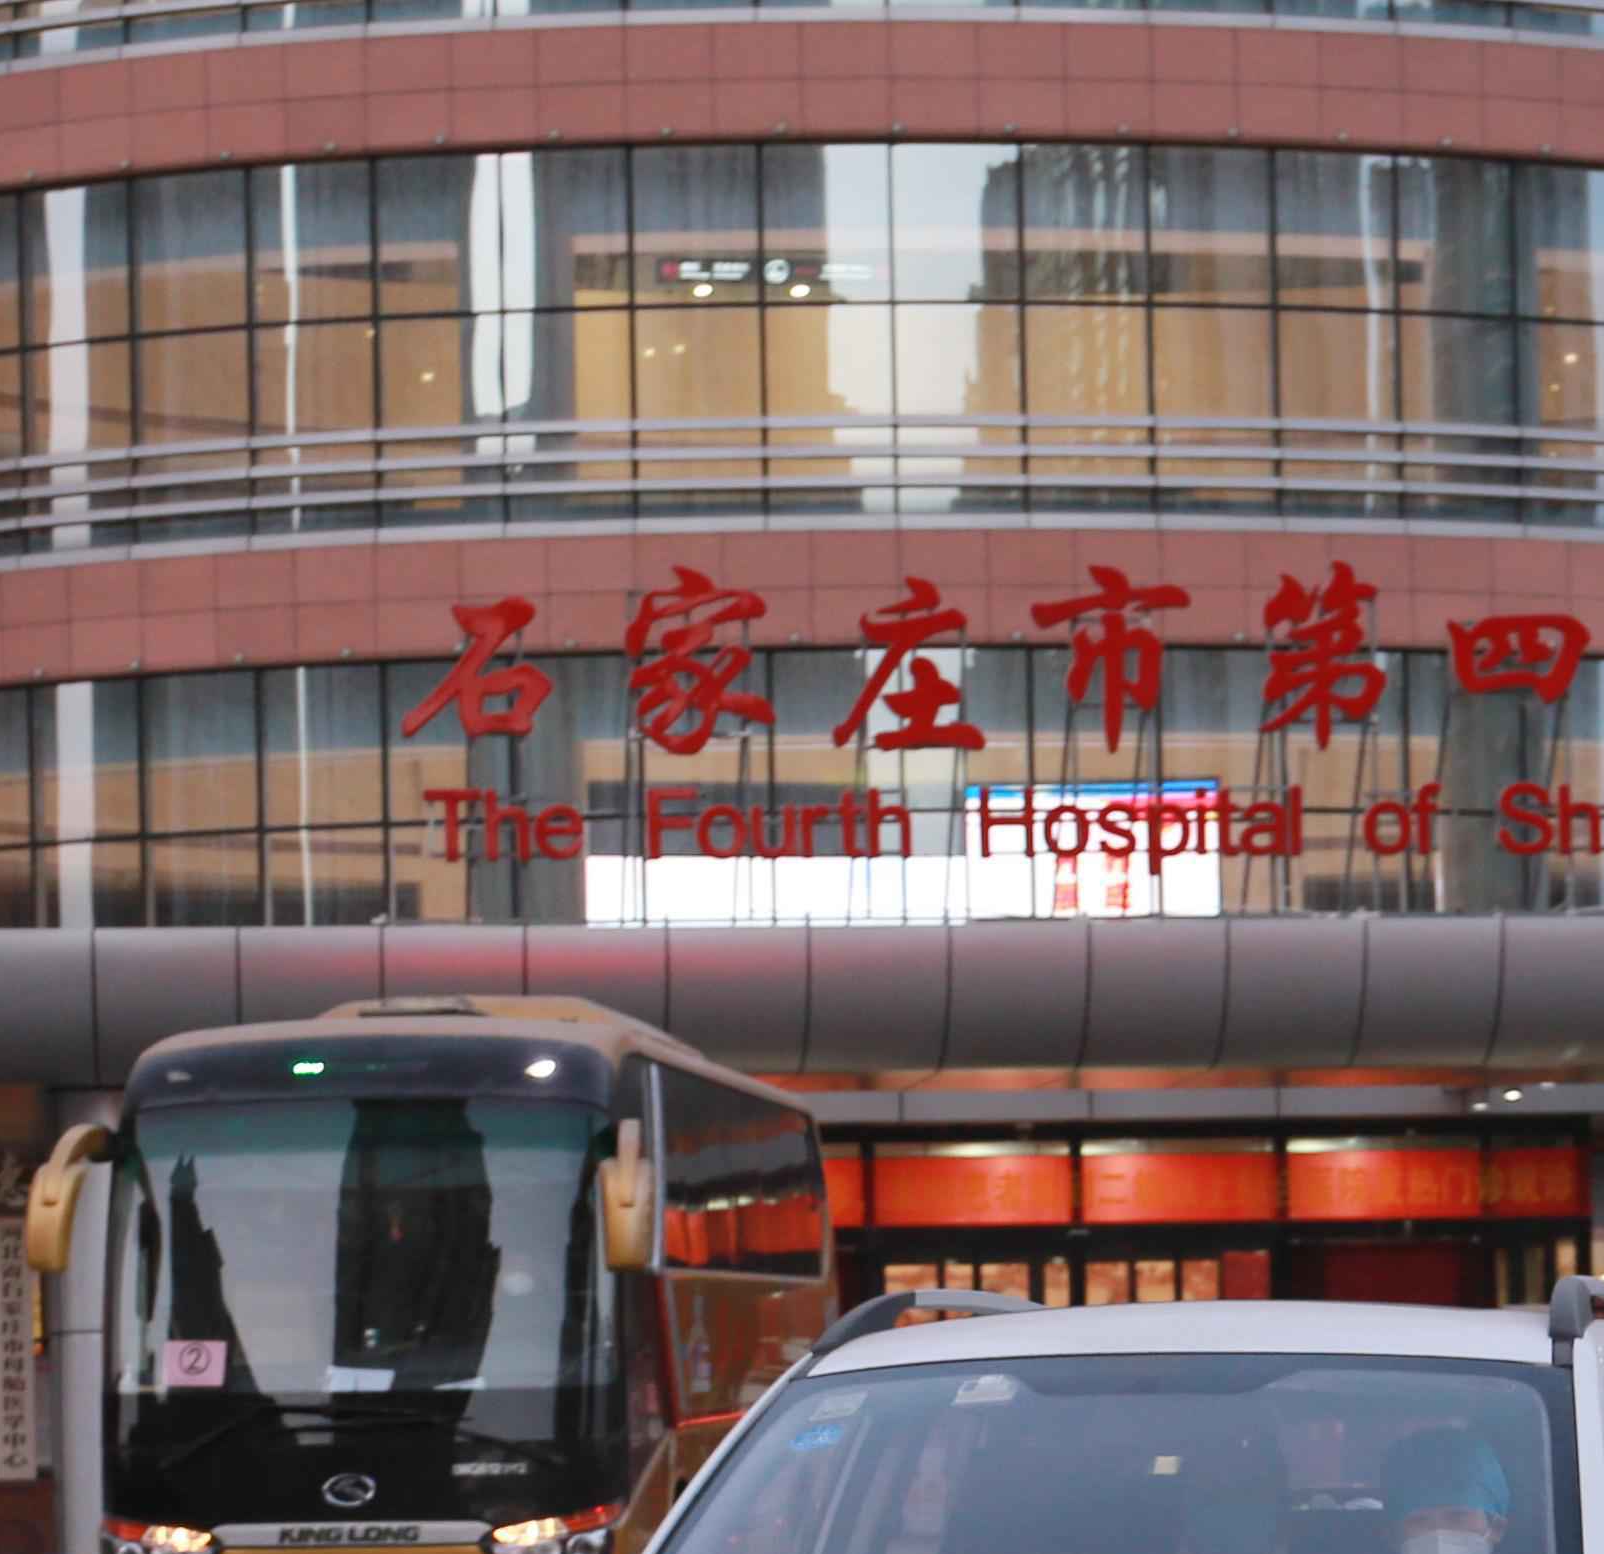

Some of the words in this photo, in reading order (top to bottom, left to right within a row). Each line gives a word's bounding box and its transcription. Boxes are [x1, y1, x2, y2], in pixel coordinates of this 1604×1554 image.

[423, 788, 585, 863] The
[646, 788, 913, 859] Fourth
[978, 786, 1303, 875] Hospital
[1363, 783, 1440, 857] of
[278, 1526, 342, 1544] KING
[348, 1525, 420, 1542] LONG
